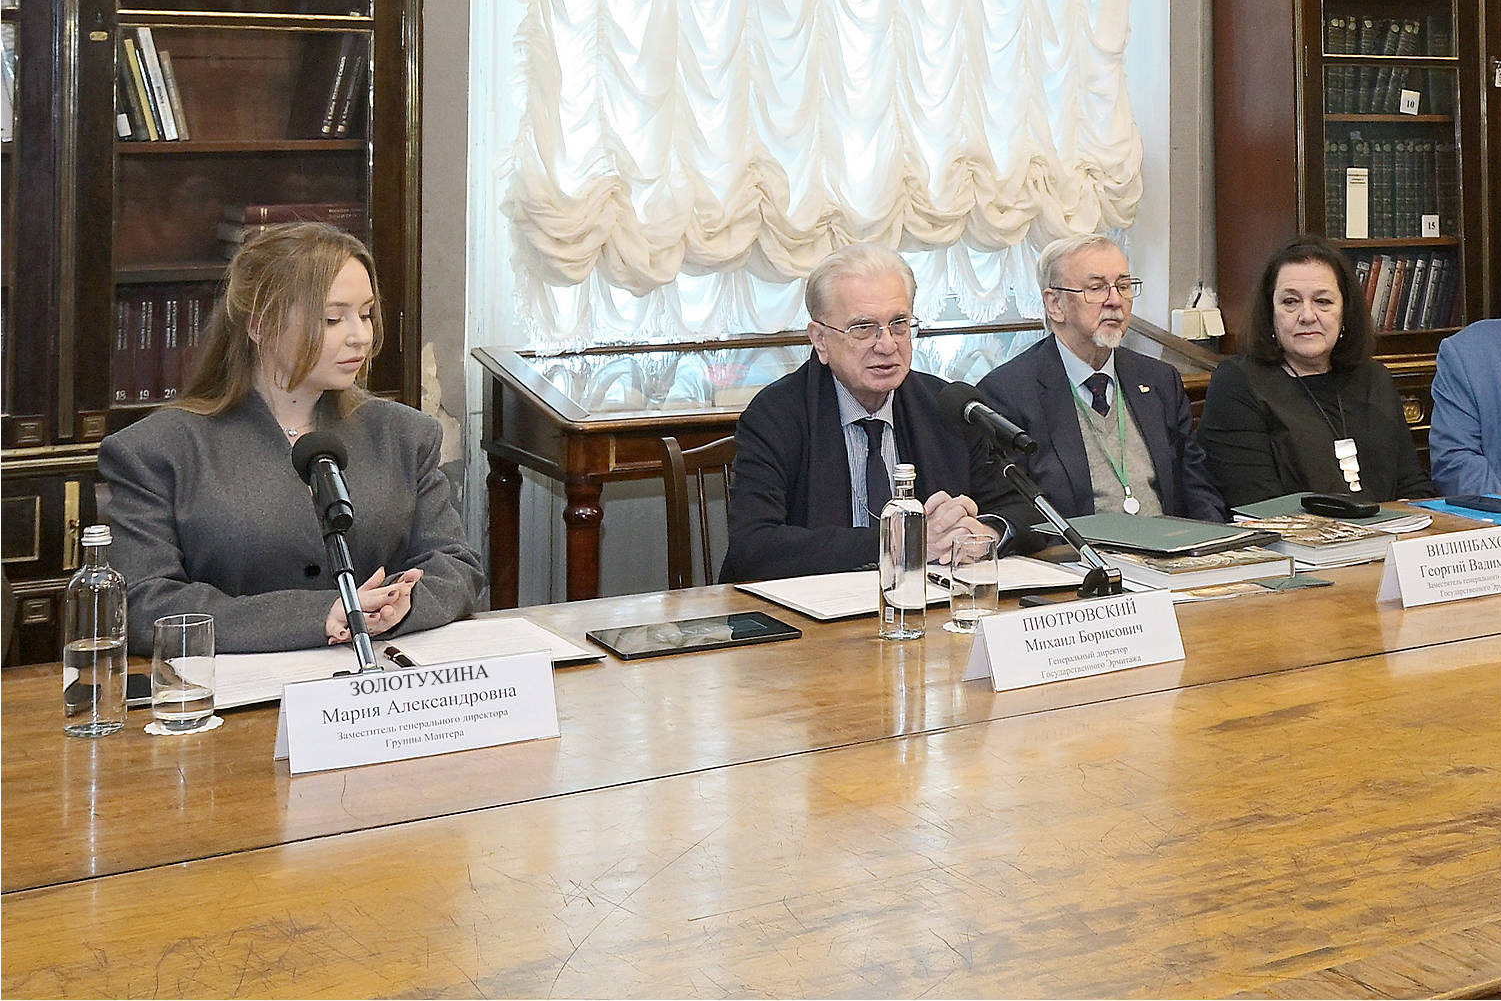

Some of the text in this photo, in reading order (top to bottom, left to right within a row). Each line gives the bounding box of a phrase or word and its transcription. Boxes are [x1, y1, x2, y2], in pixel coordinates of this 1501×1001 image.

[1406, 100, 1415, 109] 10
[1428, 221, 1436, 230] 15
[139, 389, 150, 400] 19
[164, 388, 177, 399] 20
[1420, 560, 1466, 579] Георгий
[1022, 597, 1137, 632] ПИОТРОВСКИЙ
[1025, 623, 1143, 653] Михаил Борисович
[1048, 646, 1128, 666] Генеральный директор
[1041, 655, 1142, 679] Государственного Эрмитажа
[350, 664, 489, 697] ЗОЛОТУХИНА
[321, 686, 517, 725] Мария Александровна
[337, 709, 509, 741] Заместитель генерального директора
[385, 729, 464, 750] Группы Мантера
